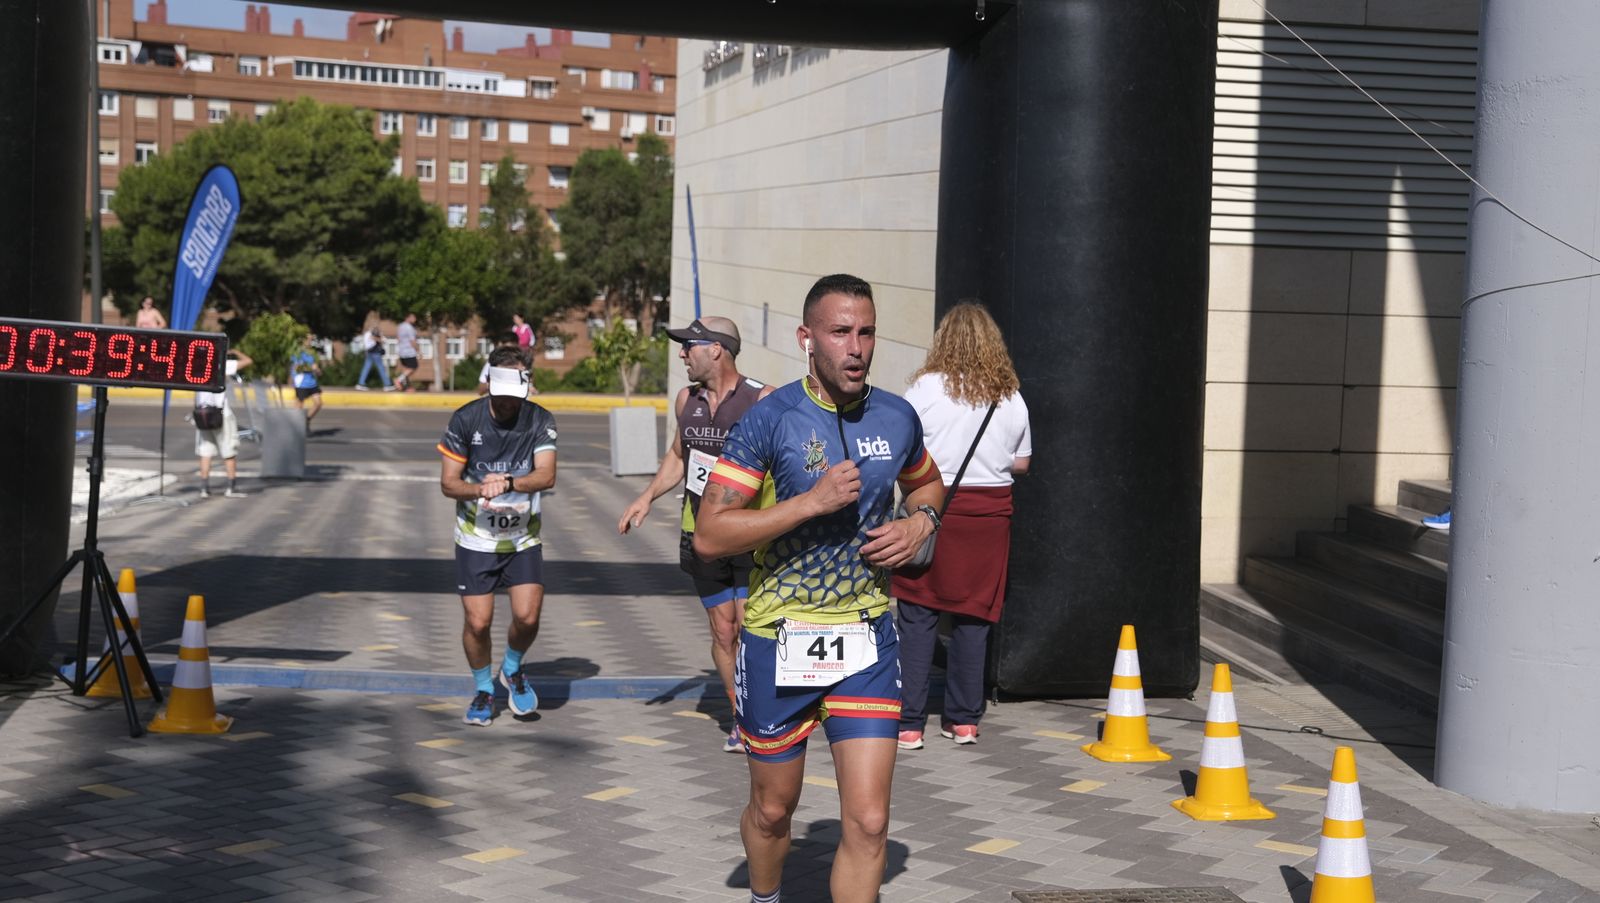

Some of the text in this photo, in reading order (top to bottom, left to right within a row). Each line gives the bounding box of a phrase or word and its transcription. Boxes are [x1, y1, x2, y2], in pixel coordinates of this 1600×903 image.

[856, 436, 892, 457] bida
[487, 515, 521, 529] 102
[806, 636, 844, 661] 41
